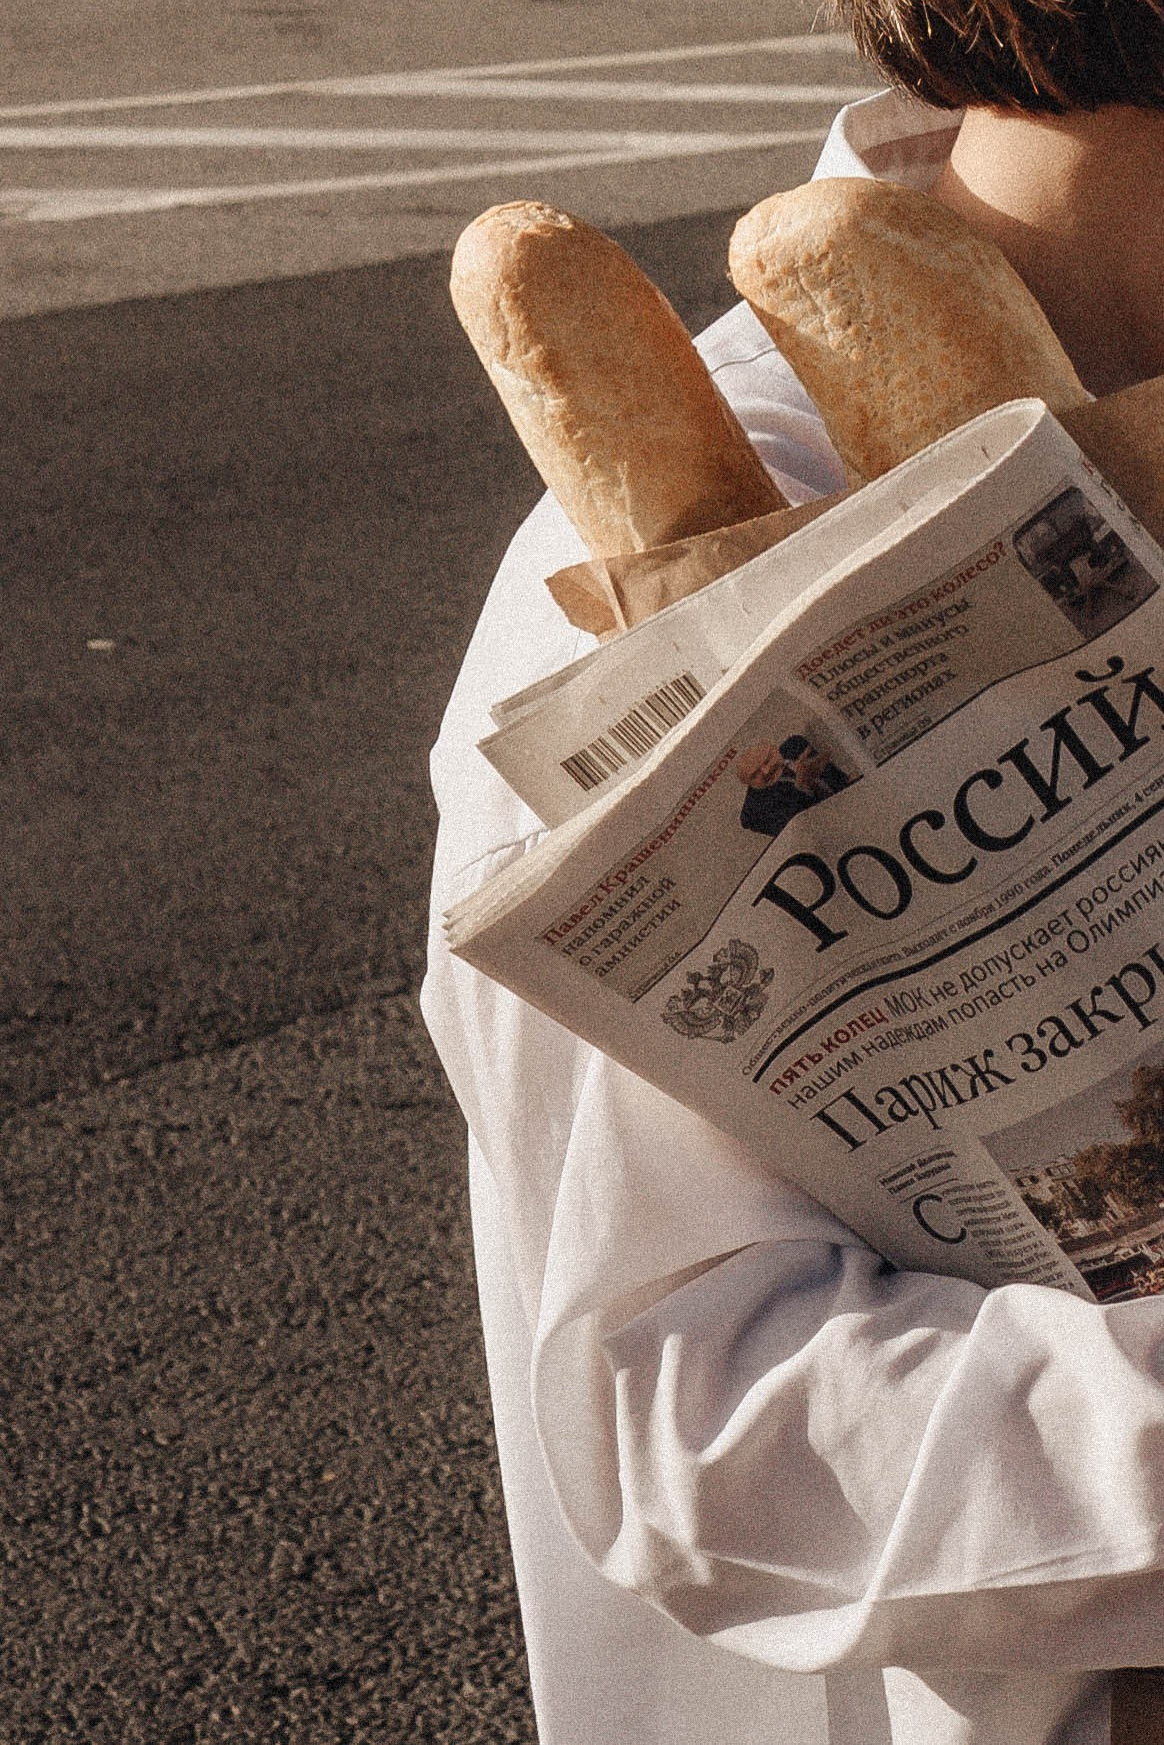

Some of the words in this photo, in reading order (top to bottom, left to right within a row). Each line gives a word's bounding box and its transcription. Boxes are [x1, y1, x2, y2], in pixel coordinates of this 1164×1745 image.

[797, 626, 865, 682] Доедет
[930, 540, 1006, 602] колесо?
[807, 643, 880, 690] Плюсы
[880, 635, 895, 649] и
[896, 597, 977, 642] минусы
[825, 622, 970, 703] общественного
[841, 651, 950, 722] транспорта
[856, 723, 873, 741] в
[870, 668, 959, 735] регионах
[542, 894, 601, 946] Павел
[599, 746, 739, 894] Крашенинников
[957, 905, 995, 932] ноября
[994, 882, 1024, 909] 1990
[1134, 792, 1144, 803] 4
[561, 874, 652, 957] напомнил
[578, 954, 592, 968] о
[590, 875, 677, 957] гаражной
[594, 898, 683, 978] амнистии
[769, 1048, 824, 1096] ПЯТЬ
[820, 1006, 890, 1054] КОЛЕЦ
[883, 986, 933, 1018] МОК
[929, 979, 959, 1005] не
[958, 910, 1074, 994] допускает
[787, 1049, 864, 1110] нашим
[861, 1013, 949, 1058] надеждам
[948, 972, 1037, 1026] попасть
[1035, 948, 1069, 978] на
[810, 1048, 1017, 1153] Париж
